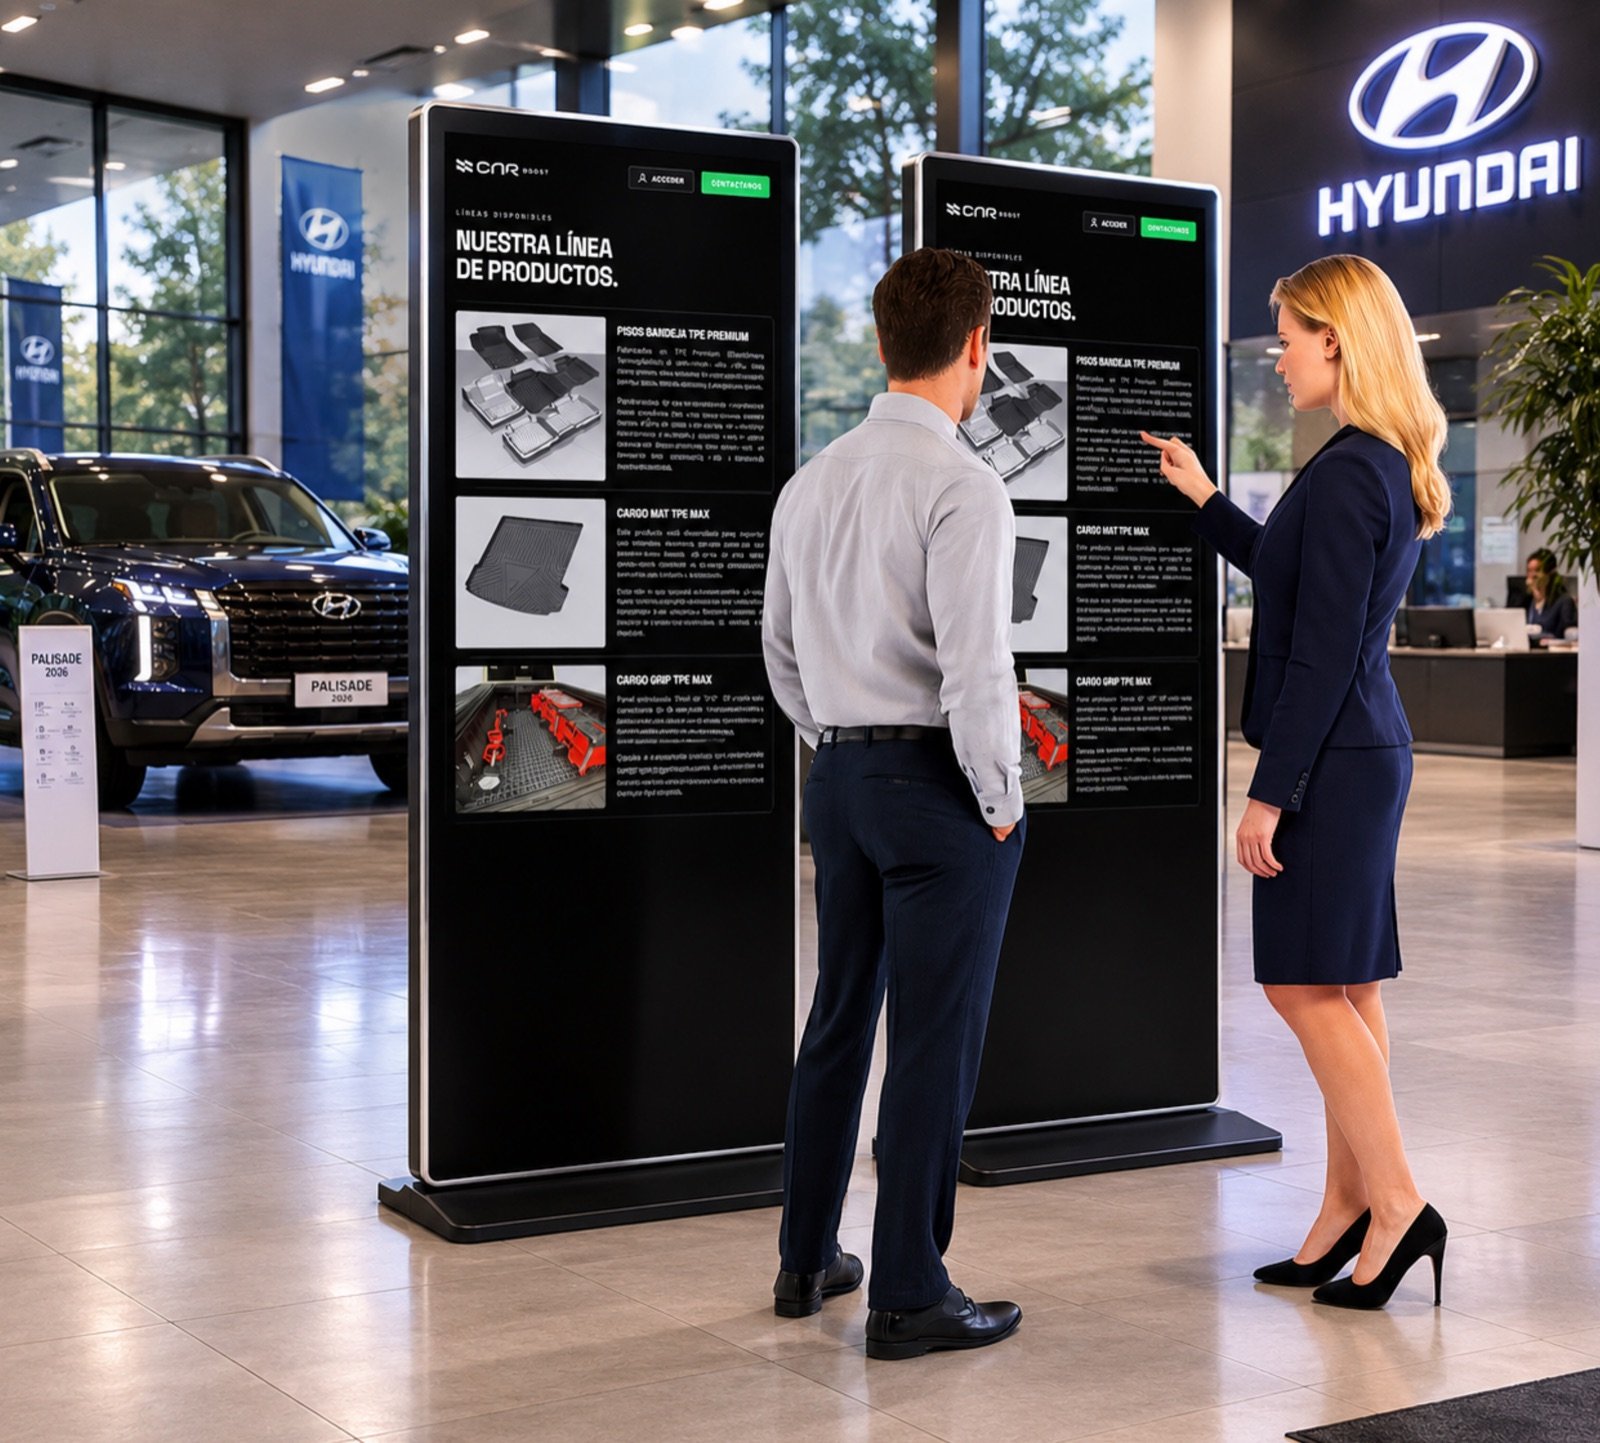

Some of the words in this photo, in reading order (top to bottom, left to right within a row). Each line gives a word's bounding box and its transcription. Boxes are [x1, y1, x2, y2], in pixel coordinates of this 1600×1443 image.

[651, 175, 685, 184] ACCEDER
[1318, 135, 1580, 237] HYUNDAI
[456, 229, 551, 255] NUESTRA
[556, 230, 613, 258] LÍNEA
[290, 251, 356, 281] HYUNDAI
[456, 258, 484, 280] DE
[488, 260, 619, 287] PRODUCTOS.
[985, 270, 1022, 292] TRA
[1025, 269, 1071, 295] LÍNEA
[617, 326, 644, 337] PISOS
[646, 327, 687, 339] BANDEJA
[689, 329, 705, 340] TPE
[707, 330, 749, 342] PREMIUM
[616, 508, 649, 519] CARGO
[650, 508, 670, 519] MAT
[672, 509, 689, 519] TPE
[690, 509, 710, 519] MAX
[1133, 527, 1150, 536] MAX
[31, 653, 83, 665] PALISADE
[311, 680, 373, 692] PALISADE
[616, 675, 649, 686] CARGO
[650, 675, 672, 685] GRIP
[673, 675, 690, 685] TPE
[692, 674, 713, 685] MAX
